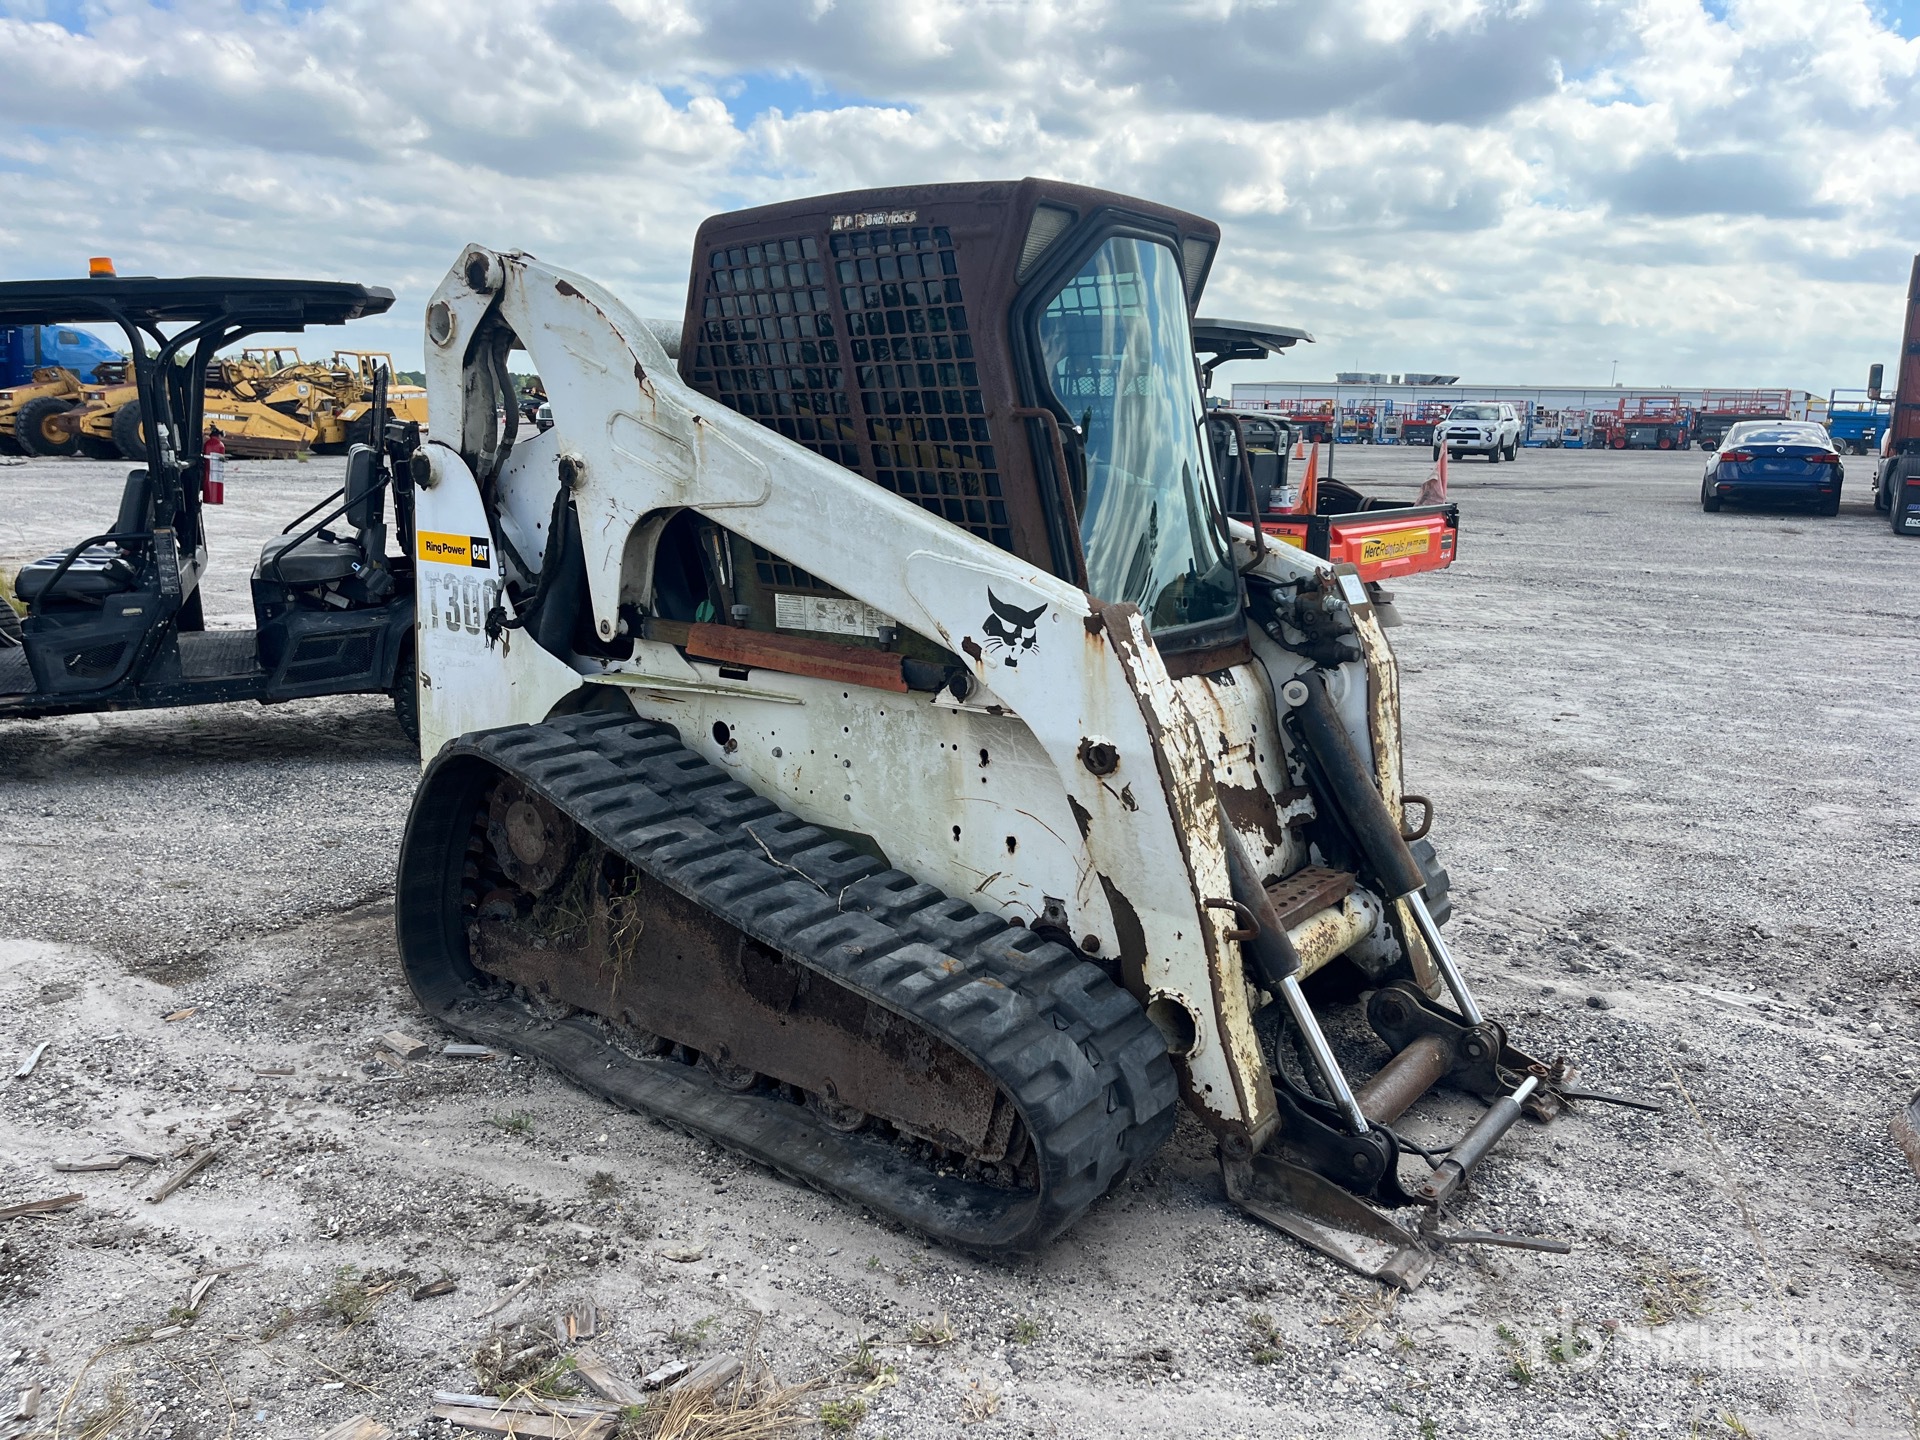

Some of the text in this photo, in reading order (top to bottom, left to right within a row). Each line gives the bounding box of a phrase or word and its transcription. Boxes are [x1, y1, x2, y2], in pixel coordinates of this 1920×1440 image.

[426, 541, 466, 555] Ring Power
[472, 544, 488, 561] CAT
